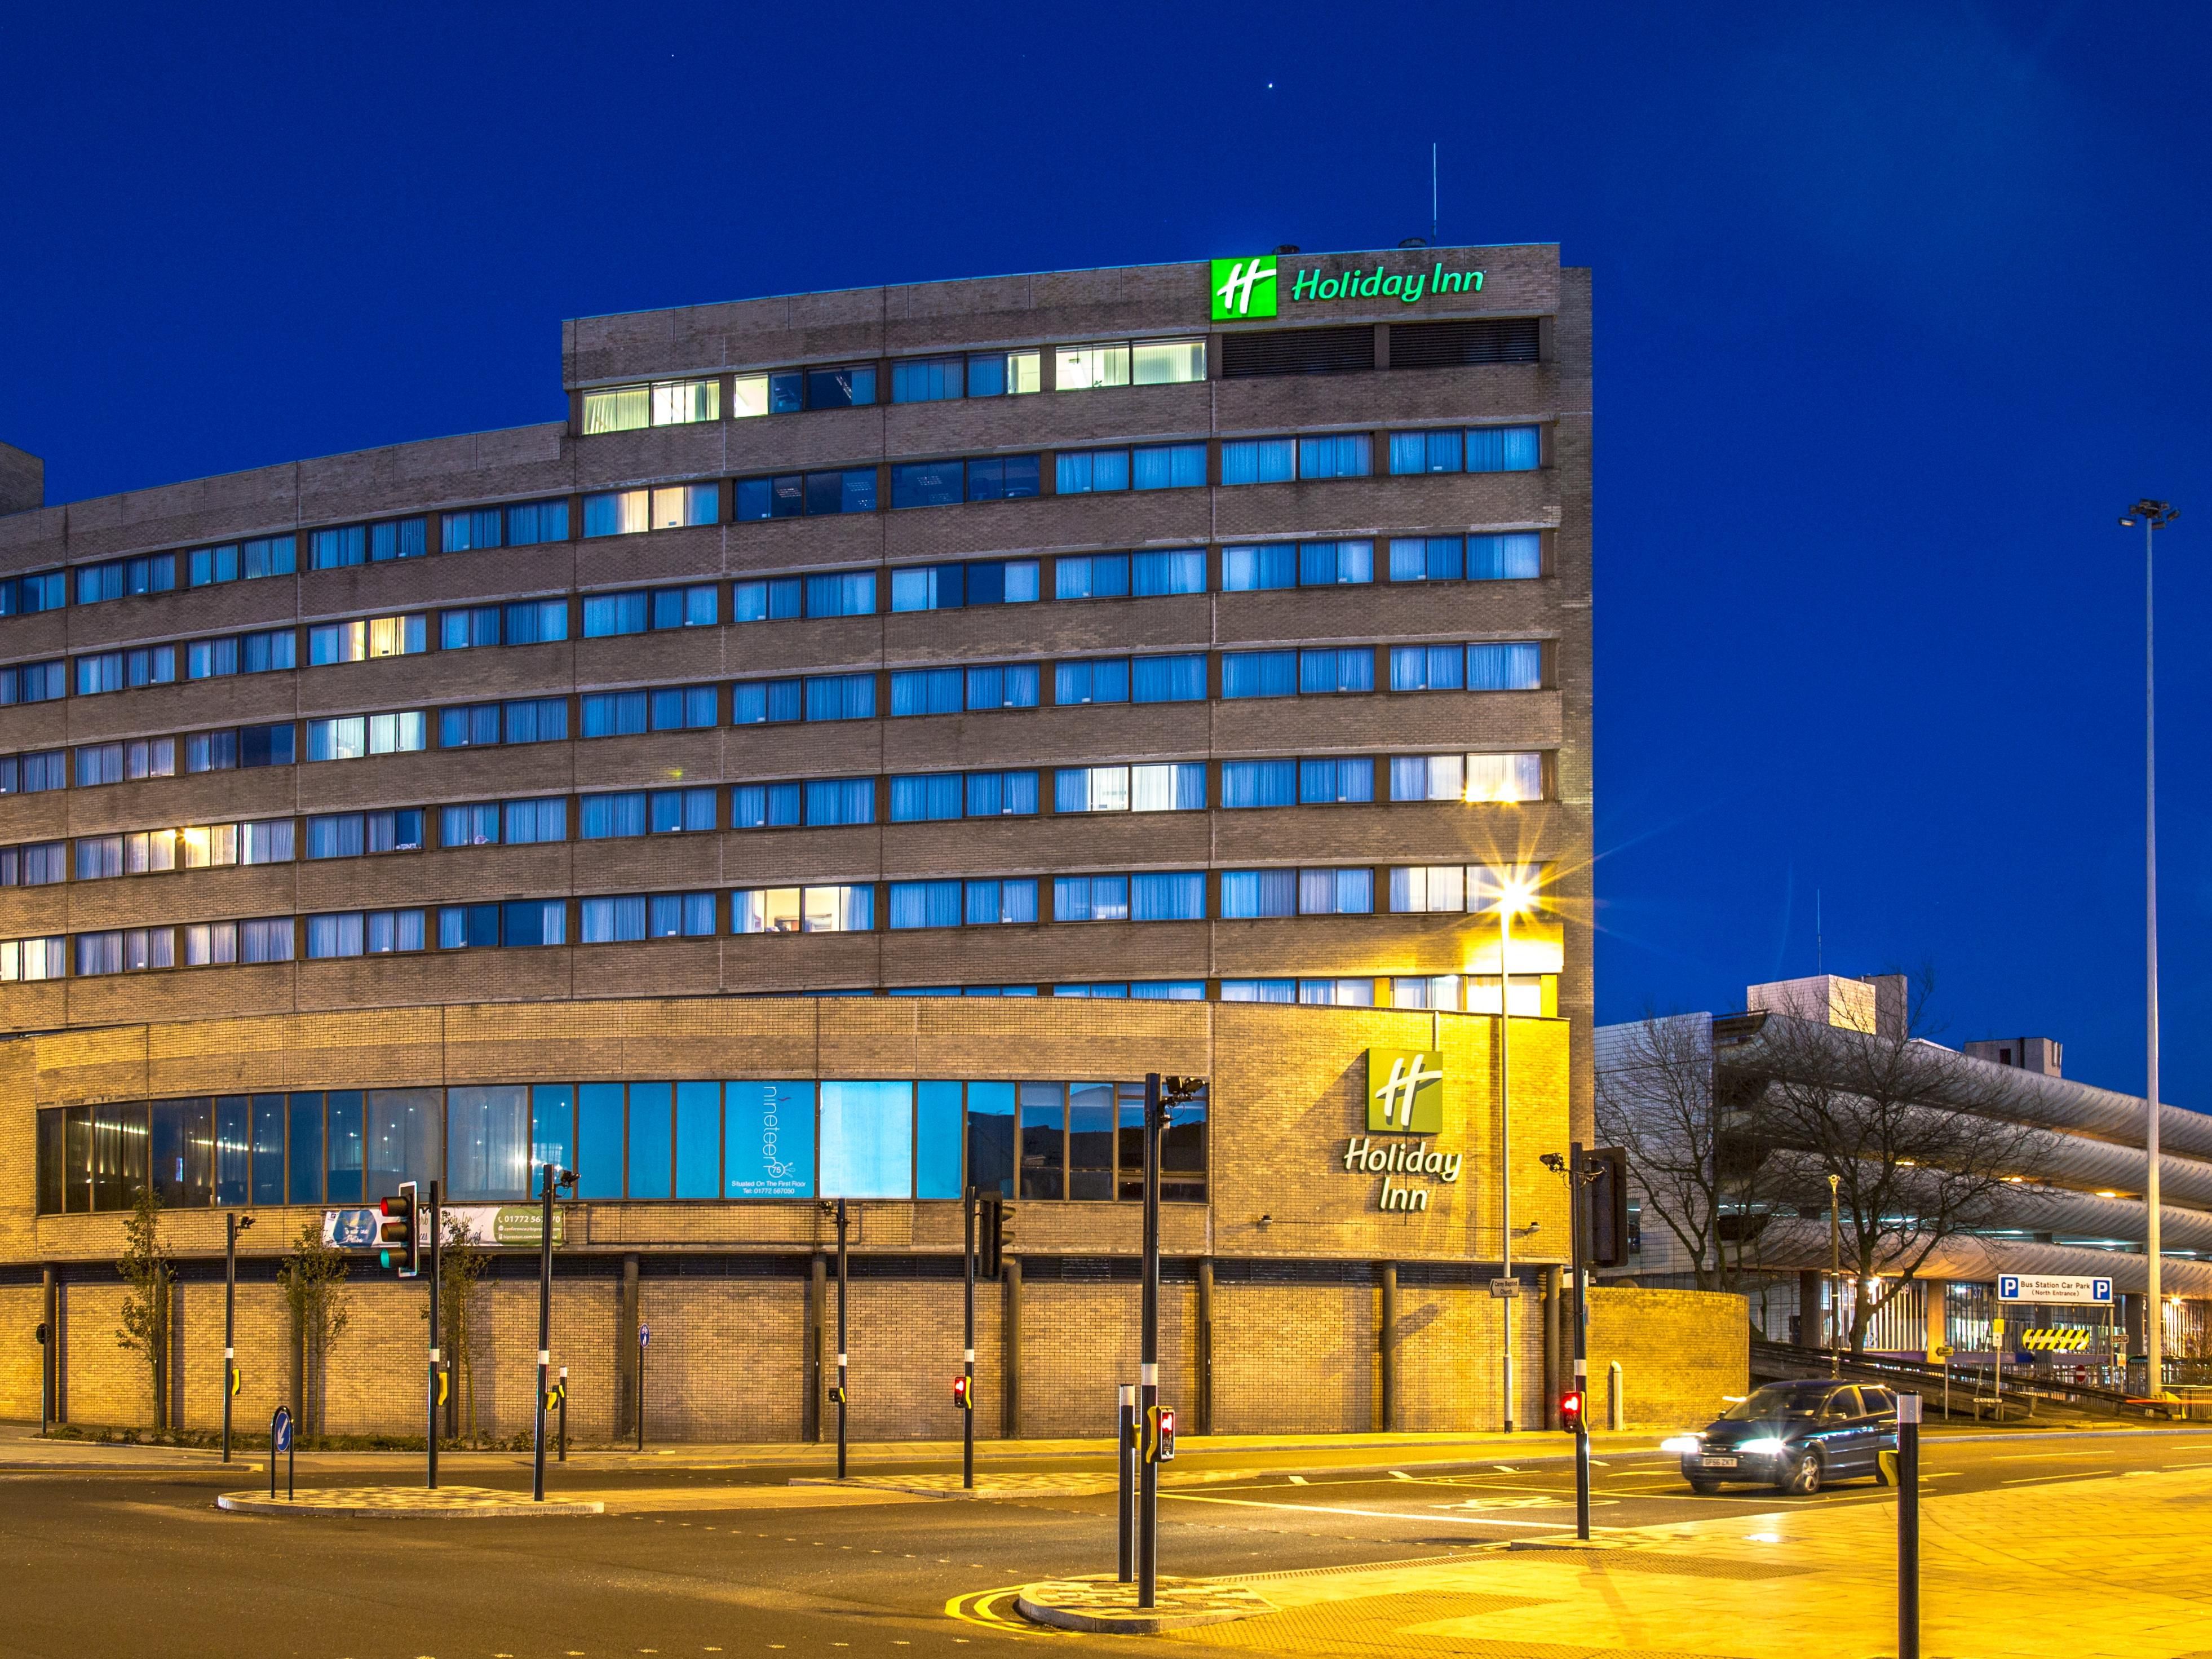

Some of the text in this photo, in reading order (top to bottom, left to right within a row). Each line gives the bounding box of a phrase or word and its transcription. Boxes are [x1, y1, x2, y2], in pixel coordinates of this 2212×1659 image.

[1291, 262, 1484, 303] Holiday Inn
[763, 1086, 781, 1168] nineteen
[1343, 1137, 1463, 1182] Holiday
[1379, 1176, 1429, 1211] Inn
[2005, 1279, 2016, 1296] P
[2097, 1281, 2108, 1299] P
